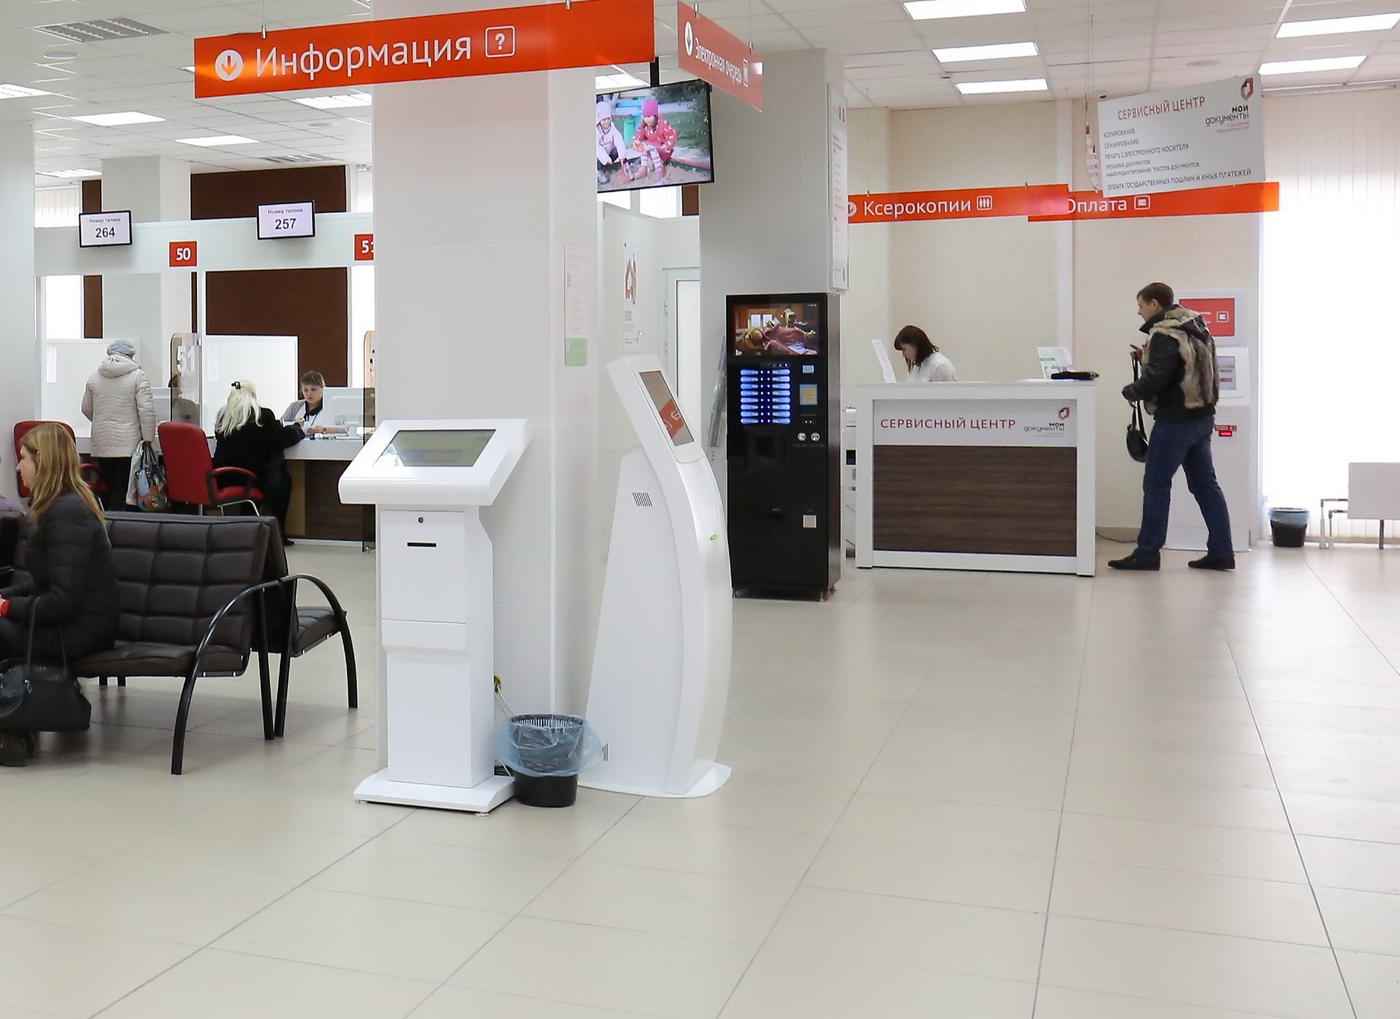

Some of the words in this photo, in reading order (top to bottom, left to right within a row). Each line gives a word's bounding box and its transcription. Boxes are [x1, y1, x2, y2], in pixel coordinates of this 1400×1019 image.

[256, 37, 472, 80] Информация
[1117, 100, 1170, 120] СЕРВИСНЫЙ
[1172, 96, 1206, 112] ЦЕНТР
[1218, 168, 1251, 178] ПЛАТЕЖЕЙ
[864, 200, 971, 219] Ксерокопии
[274, 218, 297, 230] 257
[95, 226, 116, 238] 264
[176, 247, 191, 260] 50
[880, 417, 967, 430] СЕРВИСНЫЙ
[970, 418, 1016, 431] ЦЕНТР
